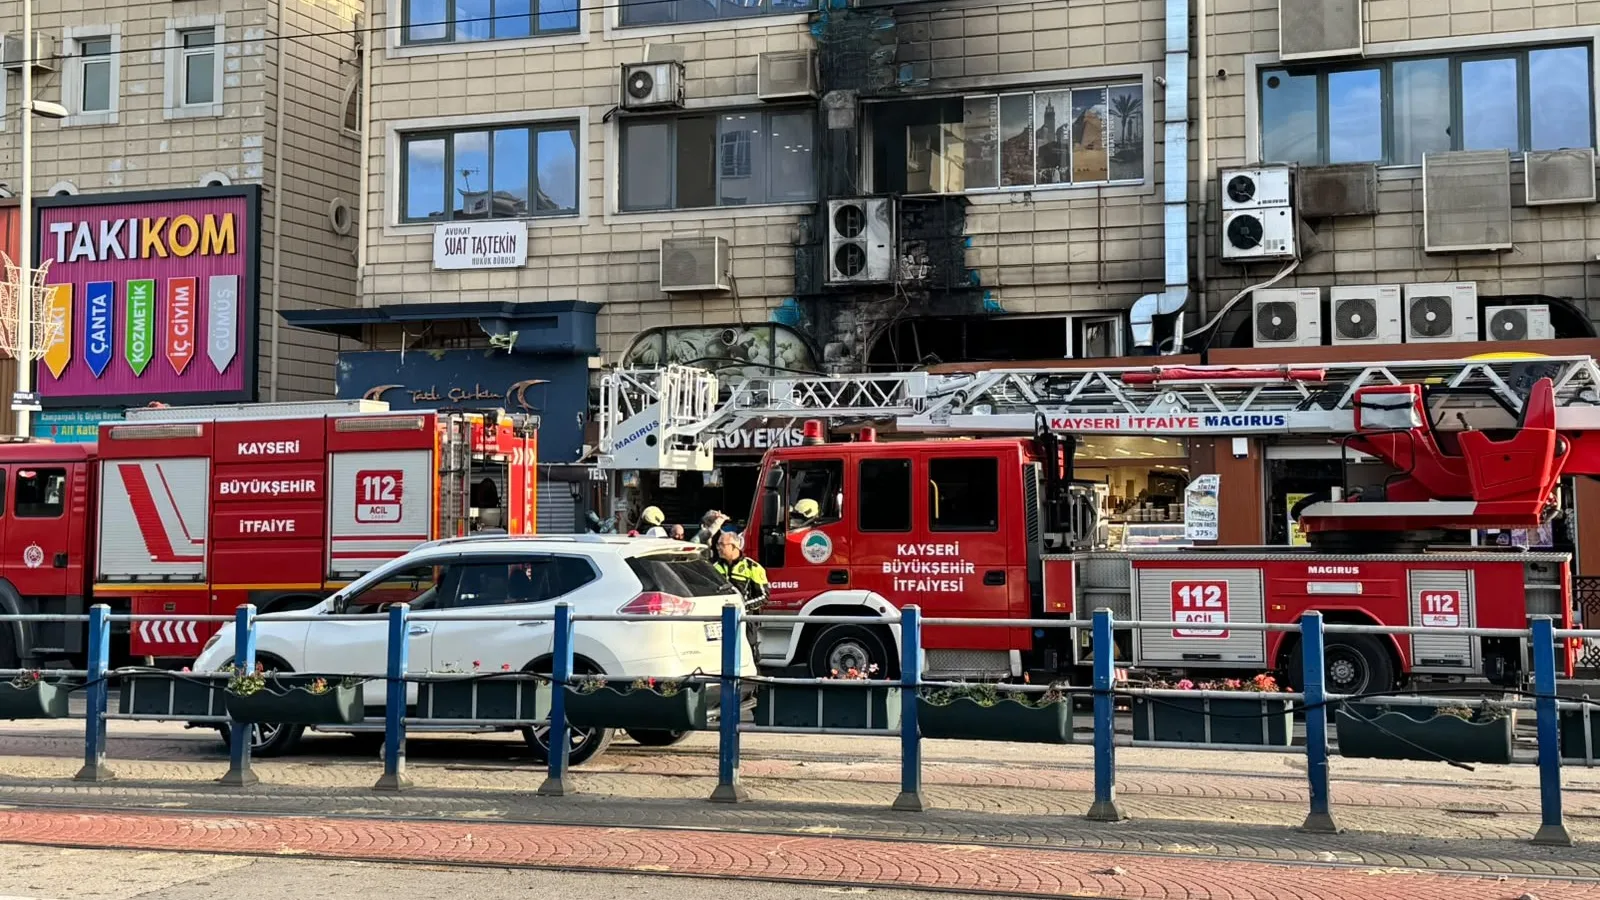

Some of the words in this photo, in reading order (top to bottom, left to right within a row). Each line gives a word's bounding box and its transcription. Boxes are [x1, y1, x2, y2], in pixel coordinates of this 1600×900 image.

[50, 213, 236, 263] TAKIKOM
[445, 227, 471, 236] AVUKAT
[445, 236, 468, 256] SUAT
[471, 231, 517, 257] TAŞTEKİN
[472, 257, 491, 265] HUKUK
[492, 255, 516, 265] BÜROSU
[171, 286, 190, 336] GİYİM
[91, 294, 109, 354] ÇANTA
[131, 284, 147, 363] KOZMETİK
[215, 289, 235, 350] GÜMÜŞ
[170, 342, 191, 357] İÇ
[1051, 415, 1120, 429] KAYSERİ
[1128, 415, 1199, 428] İTFAİYE
[1205, 415, 1285, 427] MAGIRUS
[614, 420, 660, 450] MAGIRUS
[238, 440, 300, 455] KAYSERİ
[220, 479, 316, 496] BÜYÜKŞEHİR
[363, 476, 396, 501] 112
[369, 506, 388, 514] ACİL
[239, 519, 295, 533] İTFAİYE
[897, 541, 959, 556] KAYSERİ
[882, 559, 975, 575] BÜYÜKŞEHİR
[1308, 565, 1360, 574] MAGIRUS
[768, 581, 799, 589] AGIRUS
[894, 577, 964, 592] İTFAİYESİ
[1177, 585, 1222, 608] 112
[1425, 594, 1455, 612] 112
